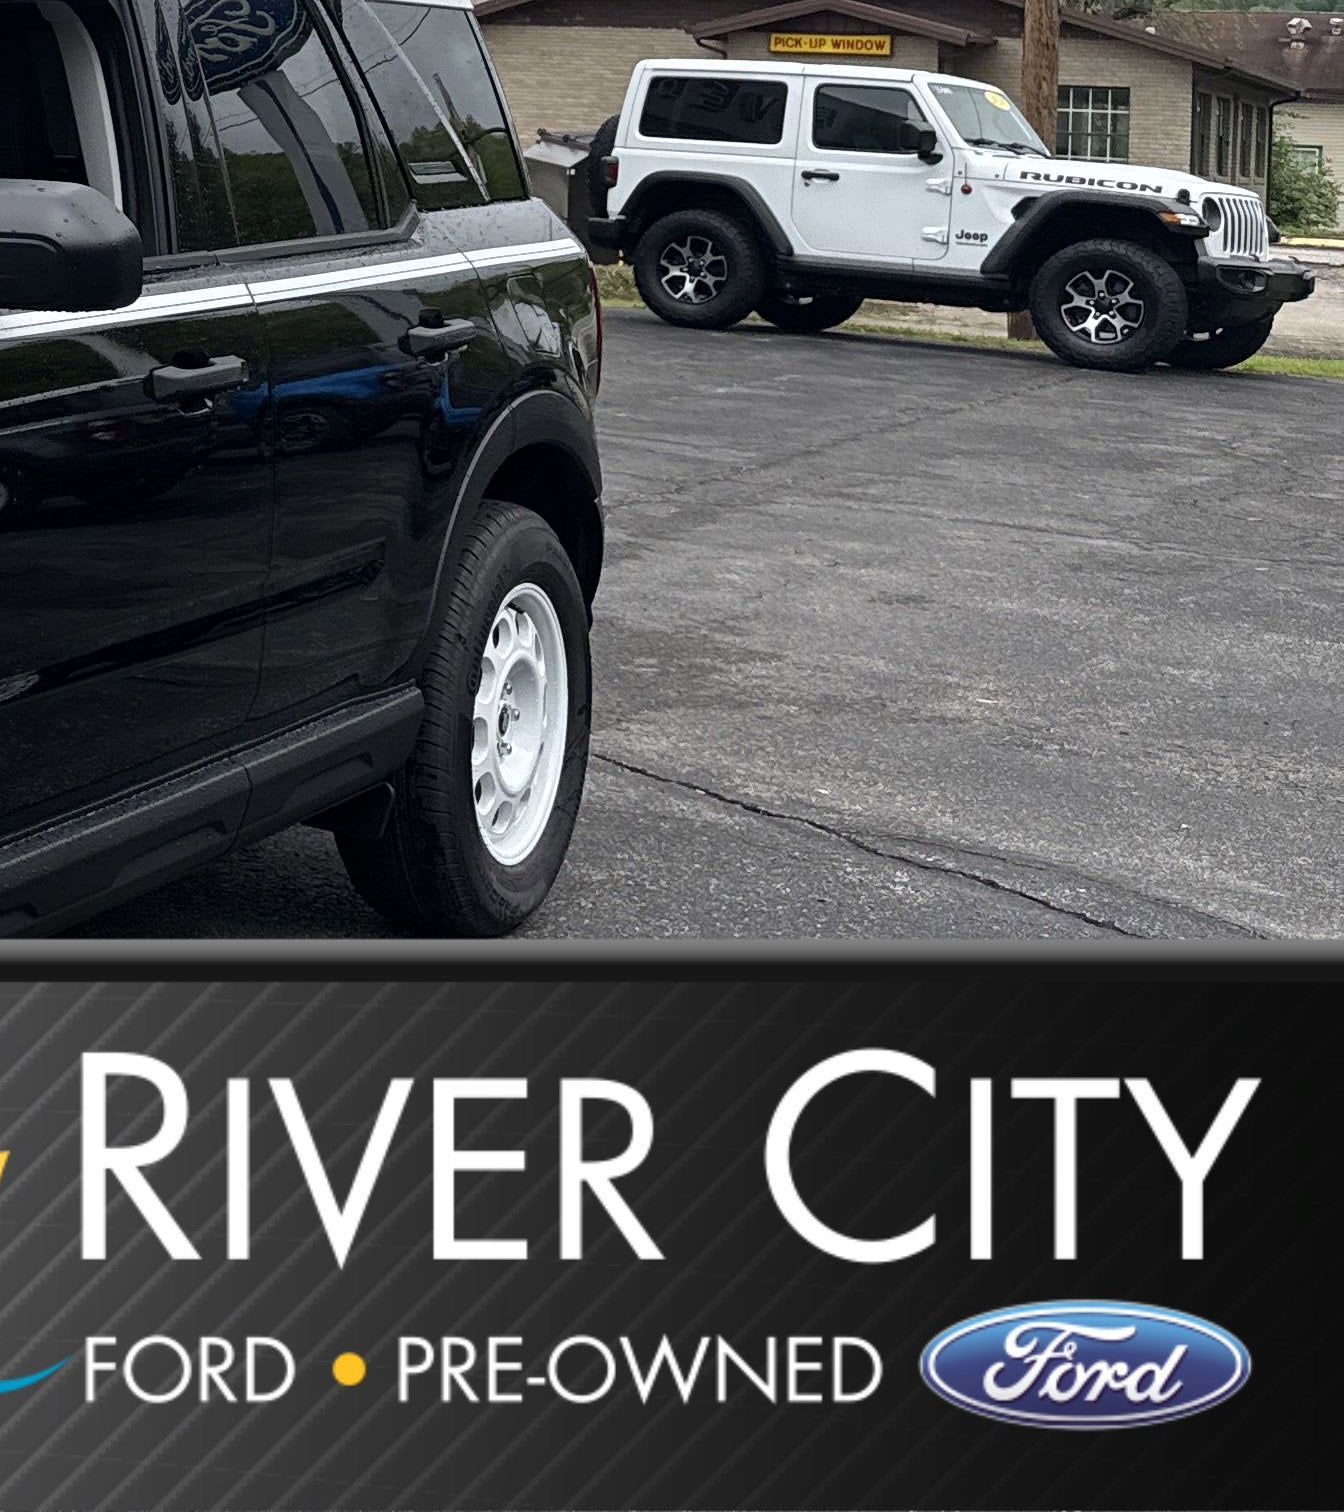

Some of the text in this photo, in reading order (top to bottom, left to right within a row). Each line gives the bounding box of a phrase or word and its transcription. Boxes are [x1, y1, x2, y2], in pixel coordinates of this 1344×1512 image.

[773, 35, 887, 52] PICK-UP WINDOW
[1019, 170, 1164, 194] RUBICON
[955, 228, 988, 243] Jeep
